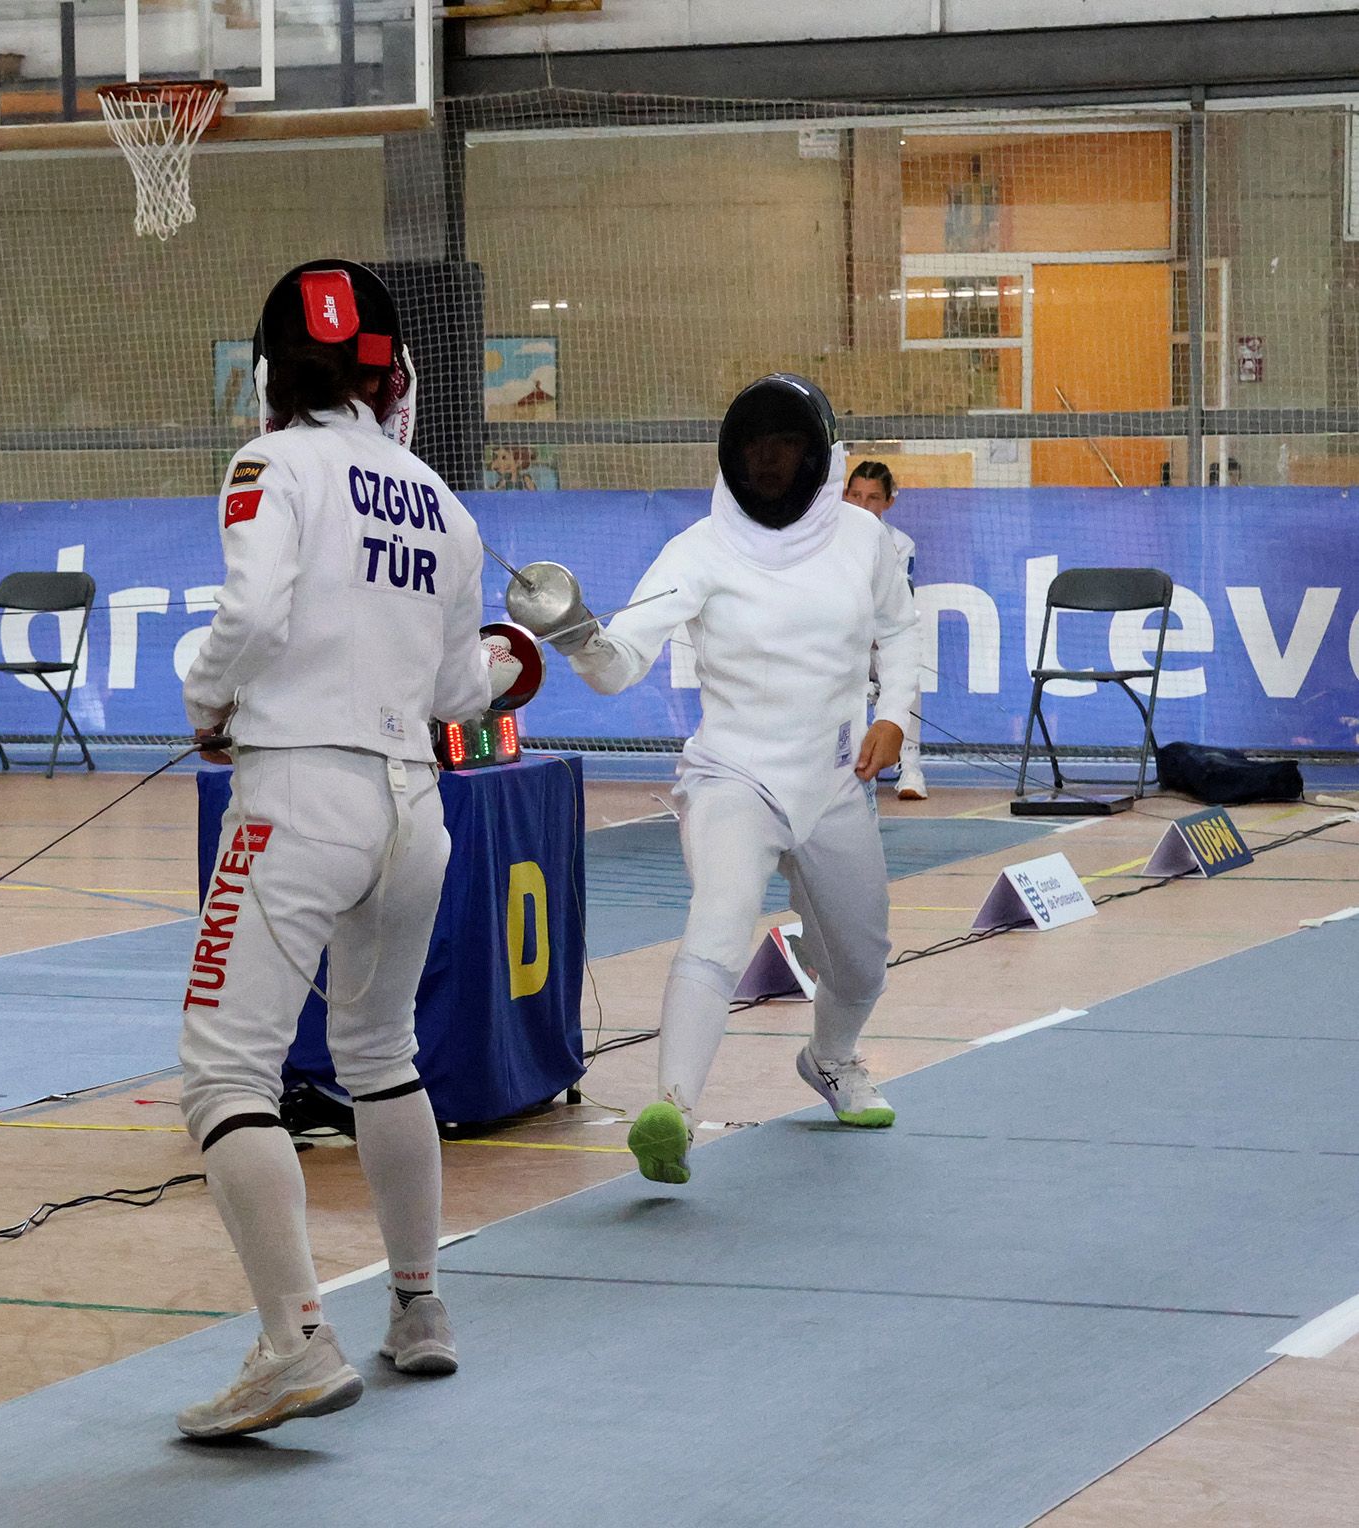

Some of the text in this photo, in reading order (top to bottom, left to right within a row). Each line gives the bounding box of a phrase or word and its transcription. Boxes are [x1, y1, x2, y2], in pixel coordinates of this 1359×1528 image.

[234, 468, 260, 478] UIPM
[349, 465, 447, 534] OZGUR
[363, 533, 436, 595] TÜR
[1185, 815, 1244, 865] UIPM
[507, 860, 550, 1001] D
